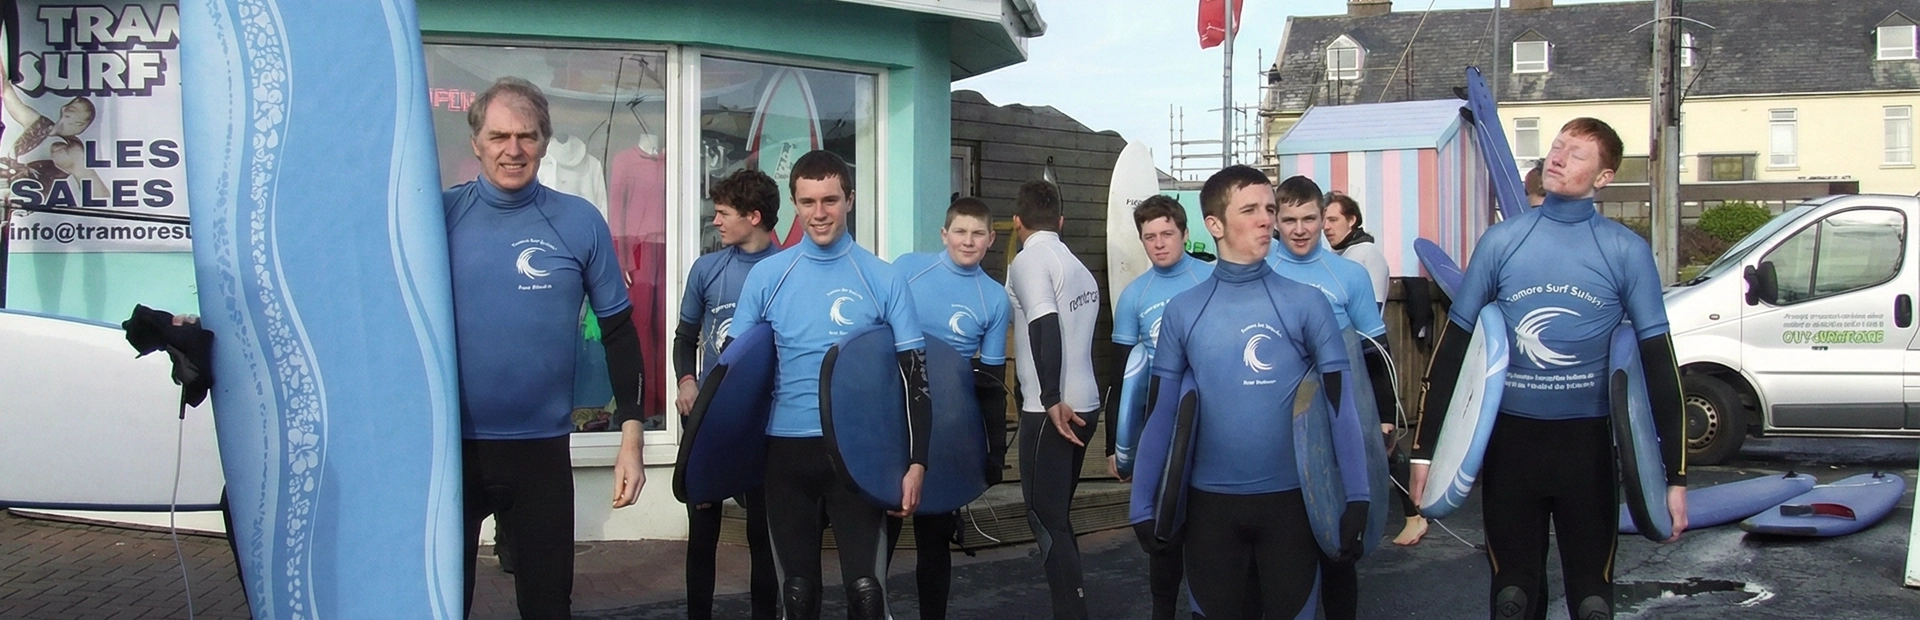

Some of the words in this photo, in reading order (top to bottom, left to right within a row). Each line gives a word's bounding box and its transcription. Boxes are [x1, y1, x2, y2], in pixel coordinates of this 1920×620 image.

[14, 51, 167, 97] SURF
[86, 140, 180, 168] LES
[12, 180, 174, 208] SALES
[1545, 283, 1570, 294] Surf
